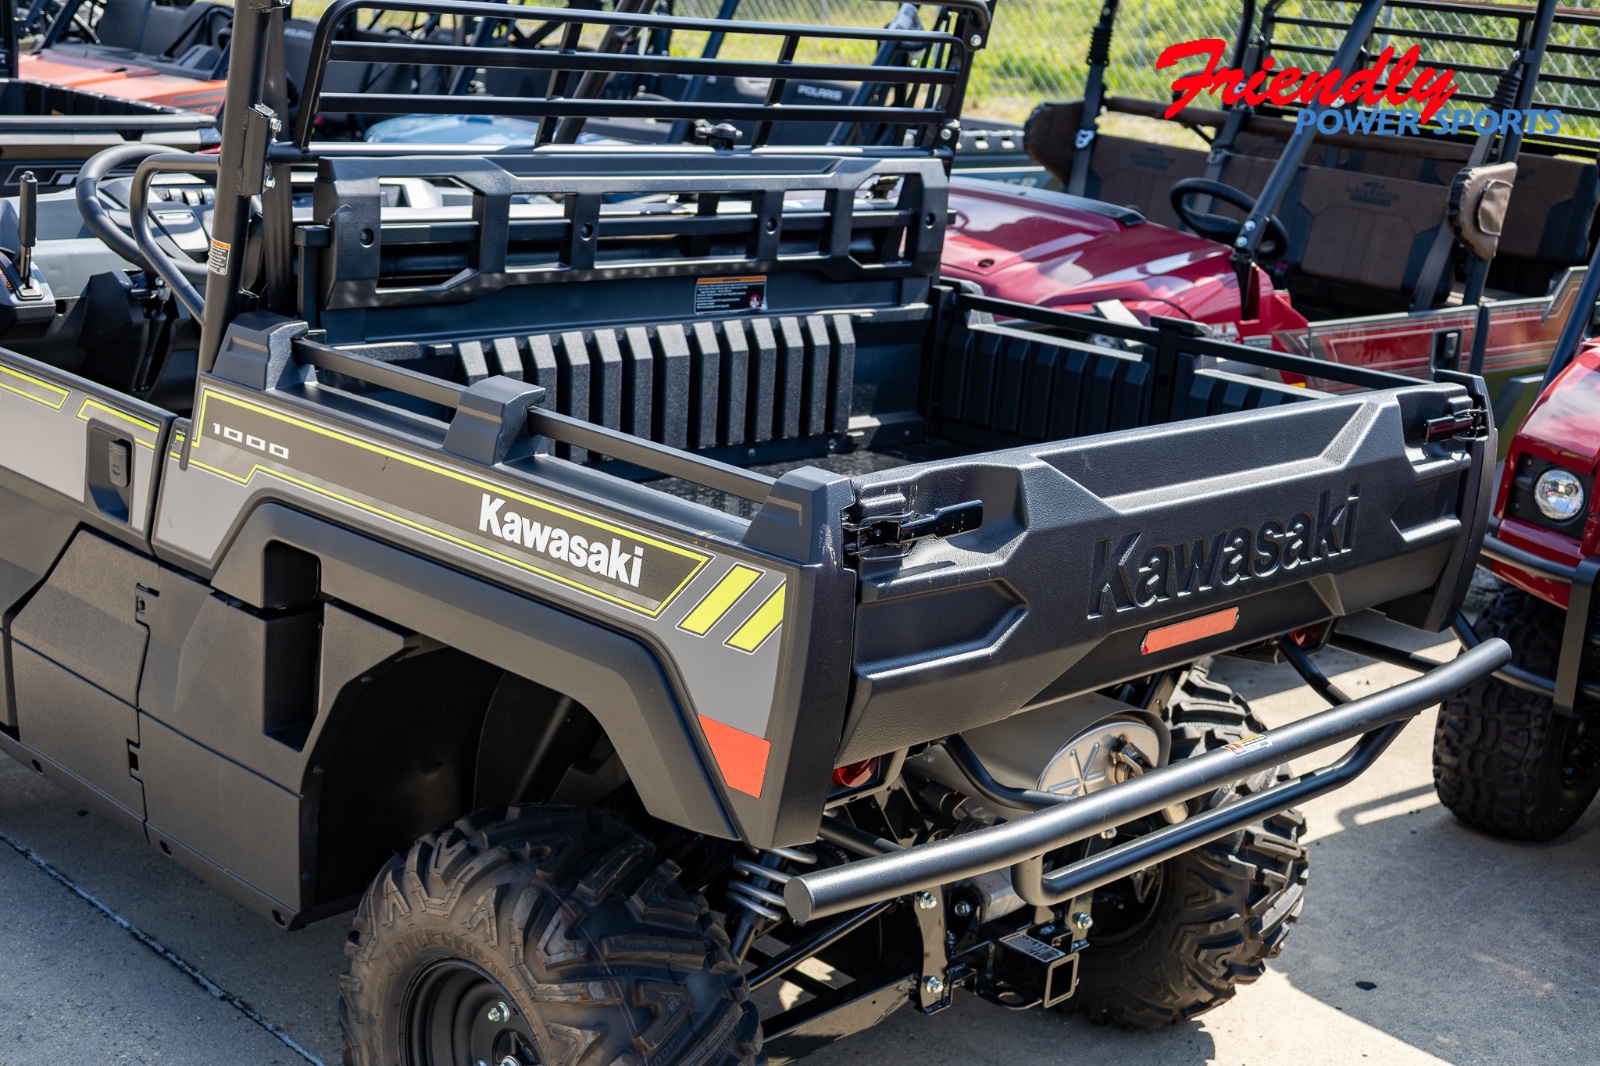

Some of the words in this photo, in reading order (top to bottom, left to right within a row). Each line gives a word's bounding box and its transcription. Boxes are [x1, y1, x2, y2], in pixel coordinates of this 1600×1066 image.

[798, 84, 843, 101] POLARIS
[213, 422, 289, 459] 1000
[478, 493, 644, 588] Kawasaki
[1087, 483, 1361, 619] Kawasaki
